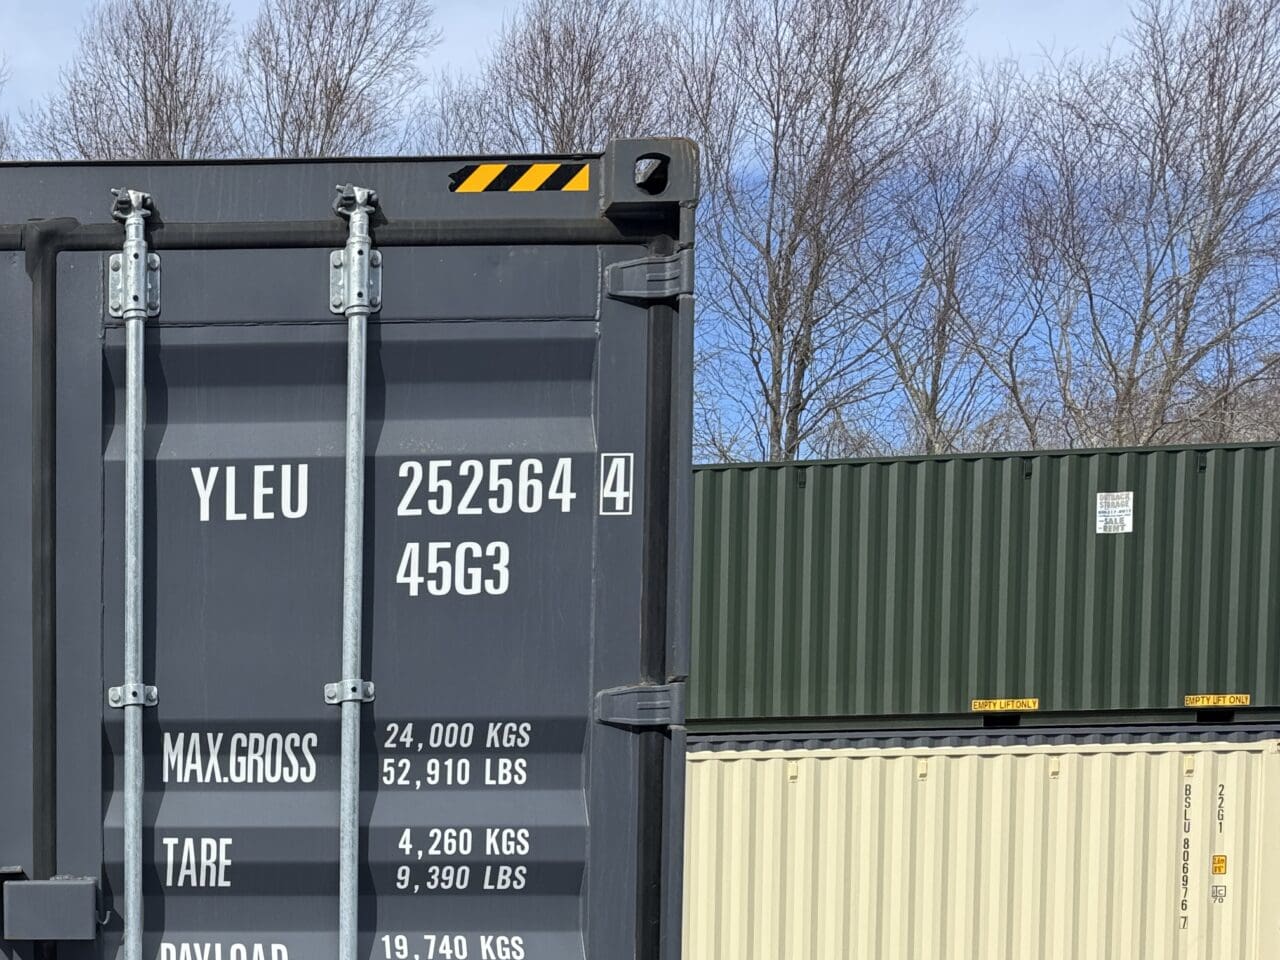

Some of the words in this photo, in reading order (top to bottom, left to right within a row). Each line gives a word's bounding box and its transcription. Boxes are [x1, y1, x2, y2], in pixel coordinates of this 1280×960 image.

[191, 463, 309, 521] YLEU
[397, 457, 576, 516] 252564
[603, 456, 630, 511] 4
[396, 541, 510, 596] 45G3
[972, 700, 998, 710] EMPTY
[999, 700, 1016, 709] LIFT
[1016, 699, 1038, 709] ONLY
[1185, 696, 1211, 705] EMPTY
[1212, 695, 1228, 705] LIFT
[1228, 695, 1250, 704] ONLY
[384, 722, 475, 752] 24,000
[486, 722, 531, 748] KGS
[162, 732, 318, 783] MAX.GROSS
[382, 758, 470, 790] 52,910
[485, 758, 527, 785] LBS
[1183, 784, 1192, 833] BSLU
[1217, 784, 1225, 833] 22G1
[398, 828, 473, 860] 4,260
[486, 828, 530, 855] KGS
[162, 837, 233, 887] TARE
[1180, 838, 1190, 911] 806976
[396, 865, 470, 893] 9,390
[483, 865, 527, 890] LBS
[1180, 916, 1187, 929] 7
[480, 935, 525, 960] KGS
